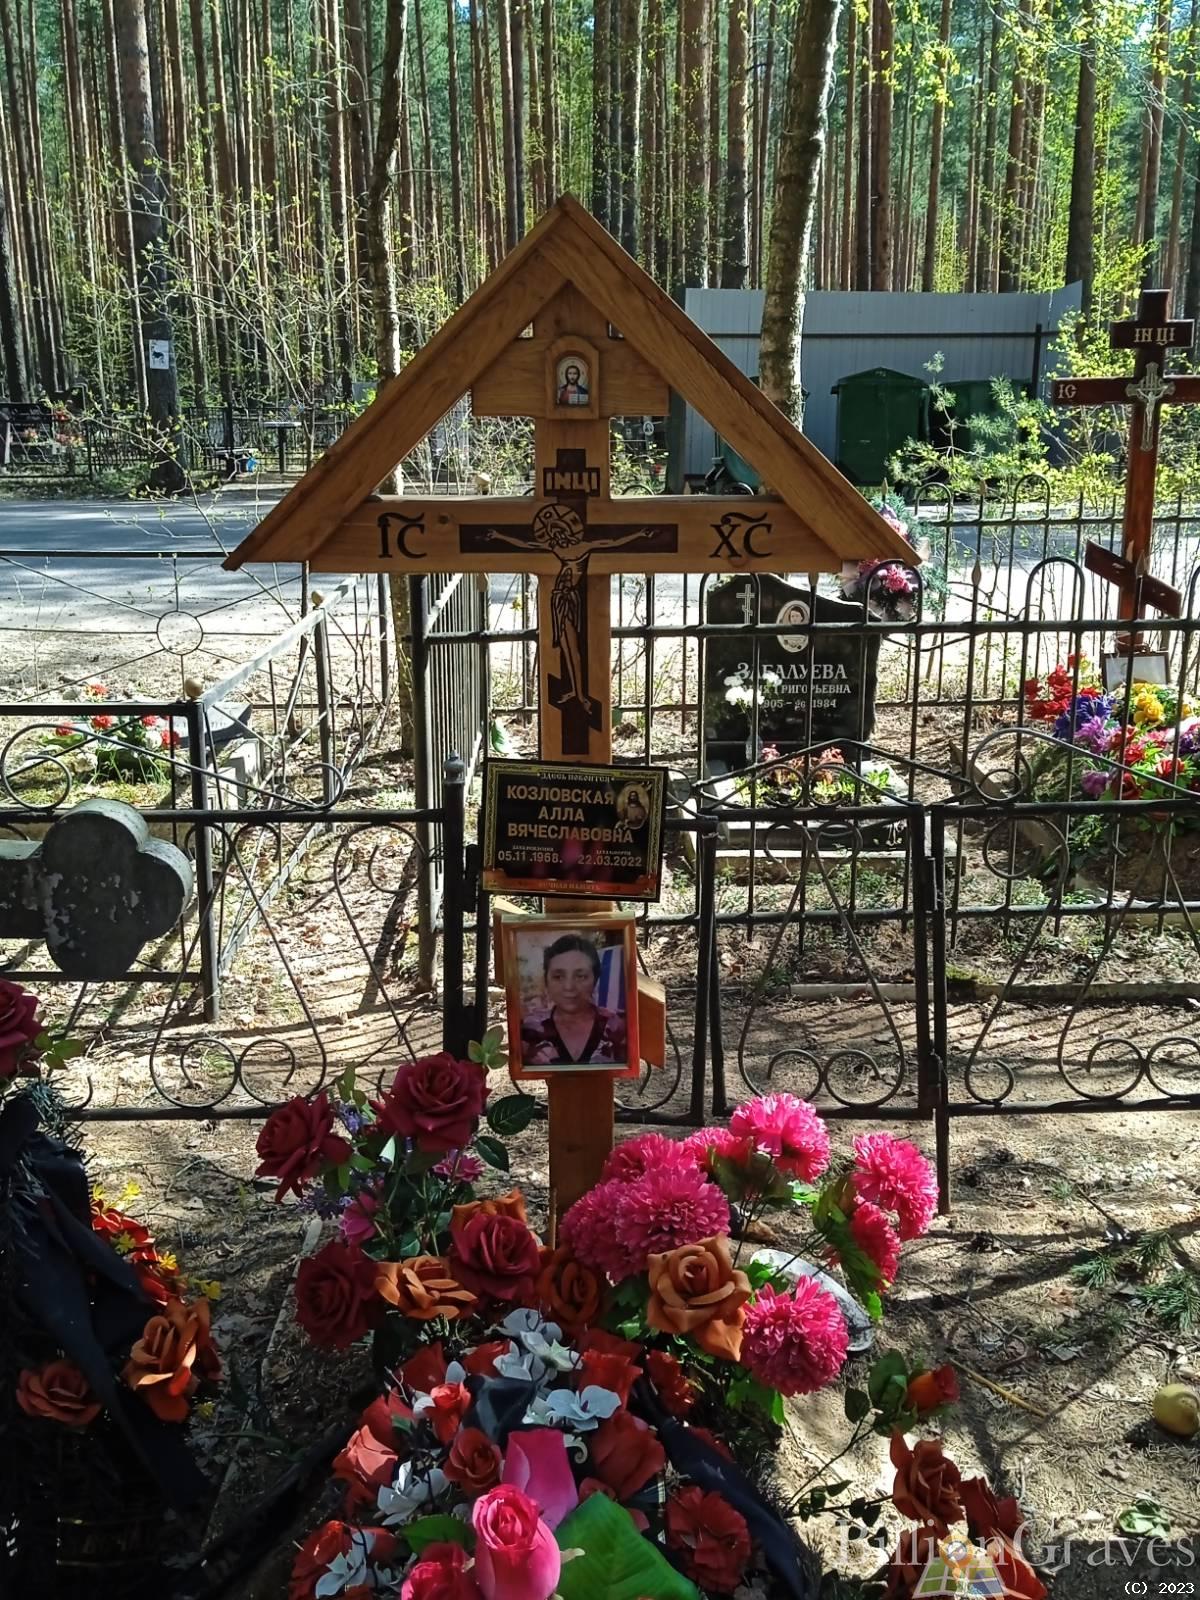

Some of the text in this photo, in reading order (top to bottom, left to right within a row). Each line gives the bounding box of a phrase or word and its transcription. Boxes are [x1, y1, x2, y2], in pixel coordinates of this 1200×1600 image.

[507, 785, 615, 805] КОЗЛОВСКАЯ
[538, 806, 585, 822] АЛЛА
[507, 823, 634, 844] ВЯЧЕСЛАВОВНА
[578, 855, 642, 867] 22.03.2022
